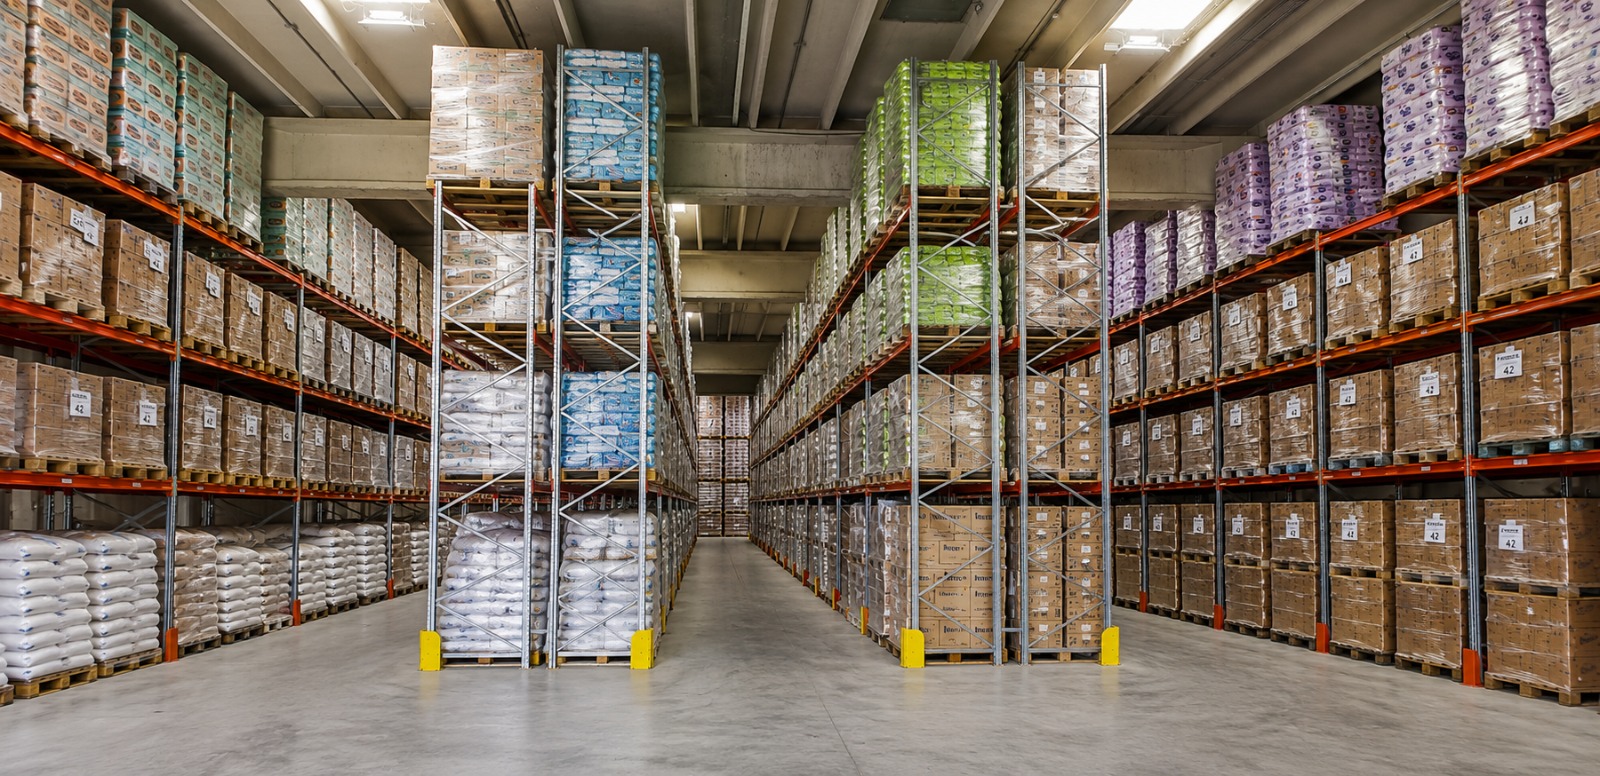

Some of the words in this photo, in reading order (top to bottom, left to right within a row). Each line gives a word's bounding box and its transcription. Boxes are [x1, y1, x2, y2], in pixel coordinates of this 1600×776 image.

[1503, 365, 1515, 375] 42
[74, 404, 84, 414] 42
[1430, 532, 1440, 540] 42
[1505, 539, 1516, 549] 42
